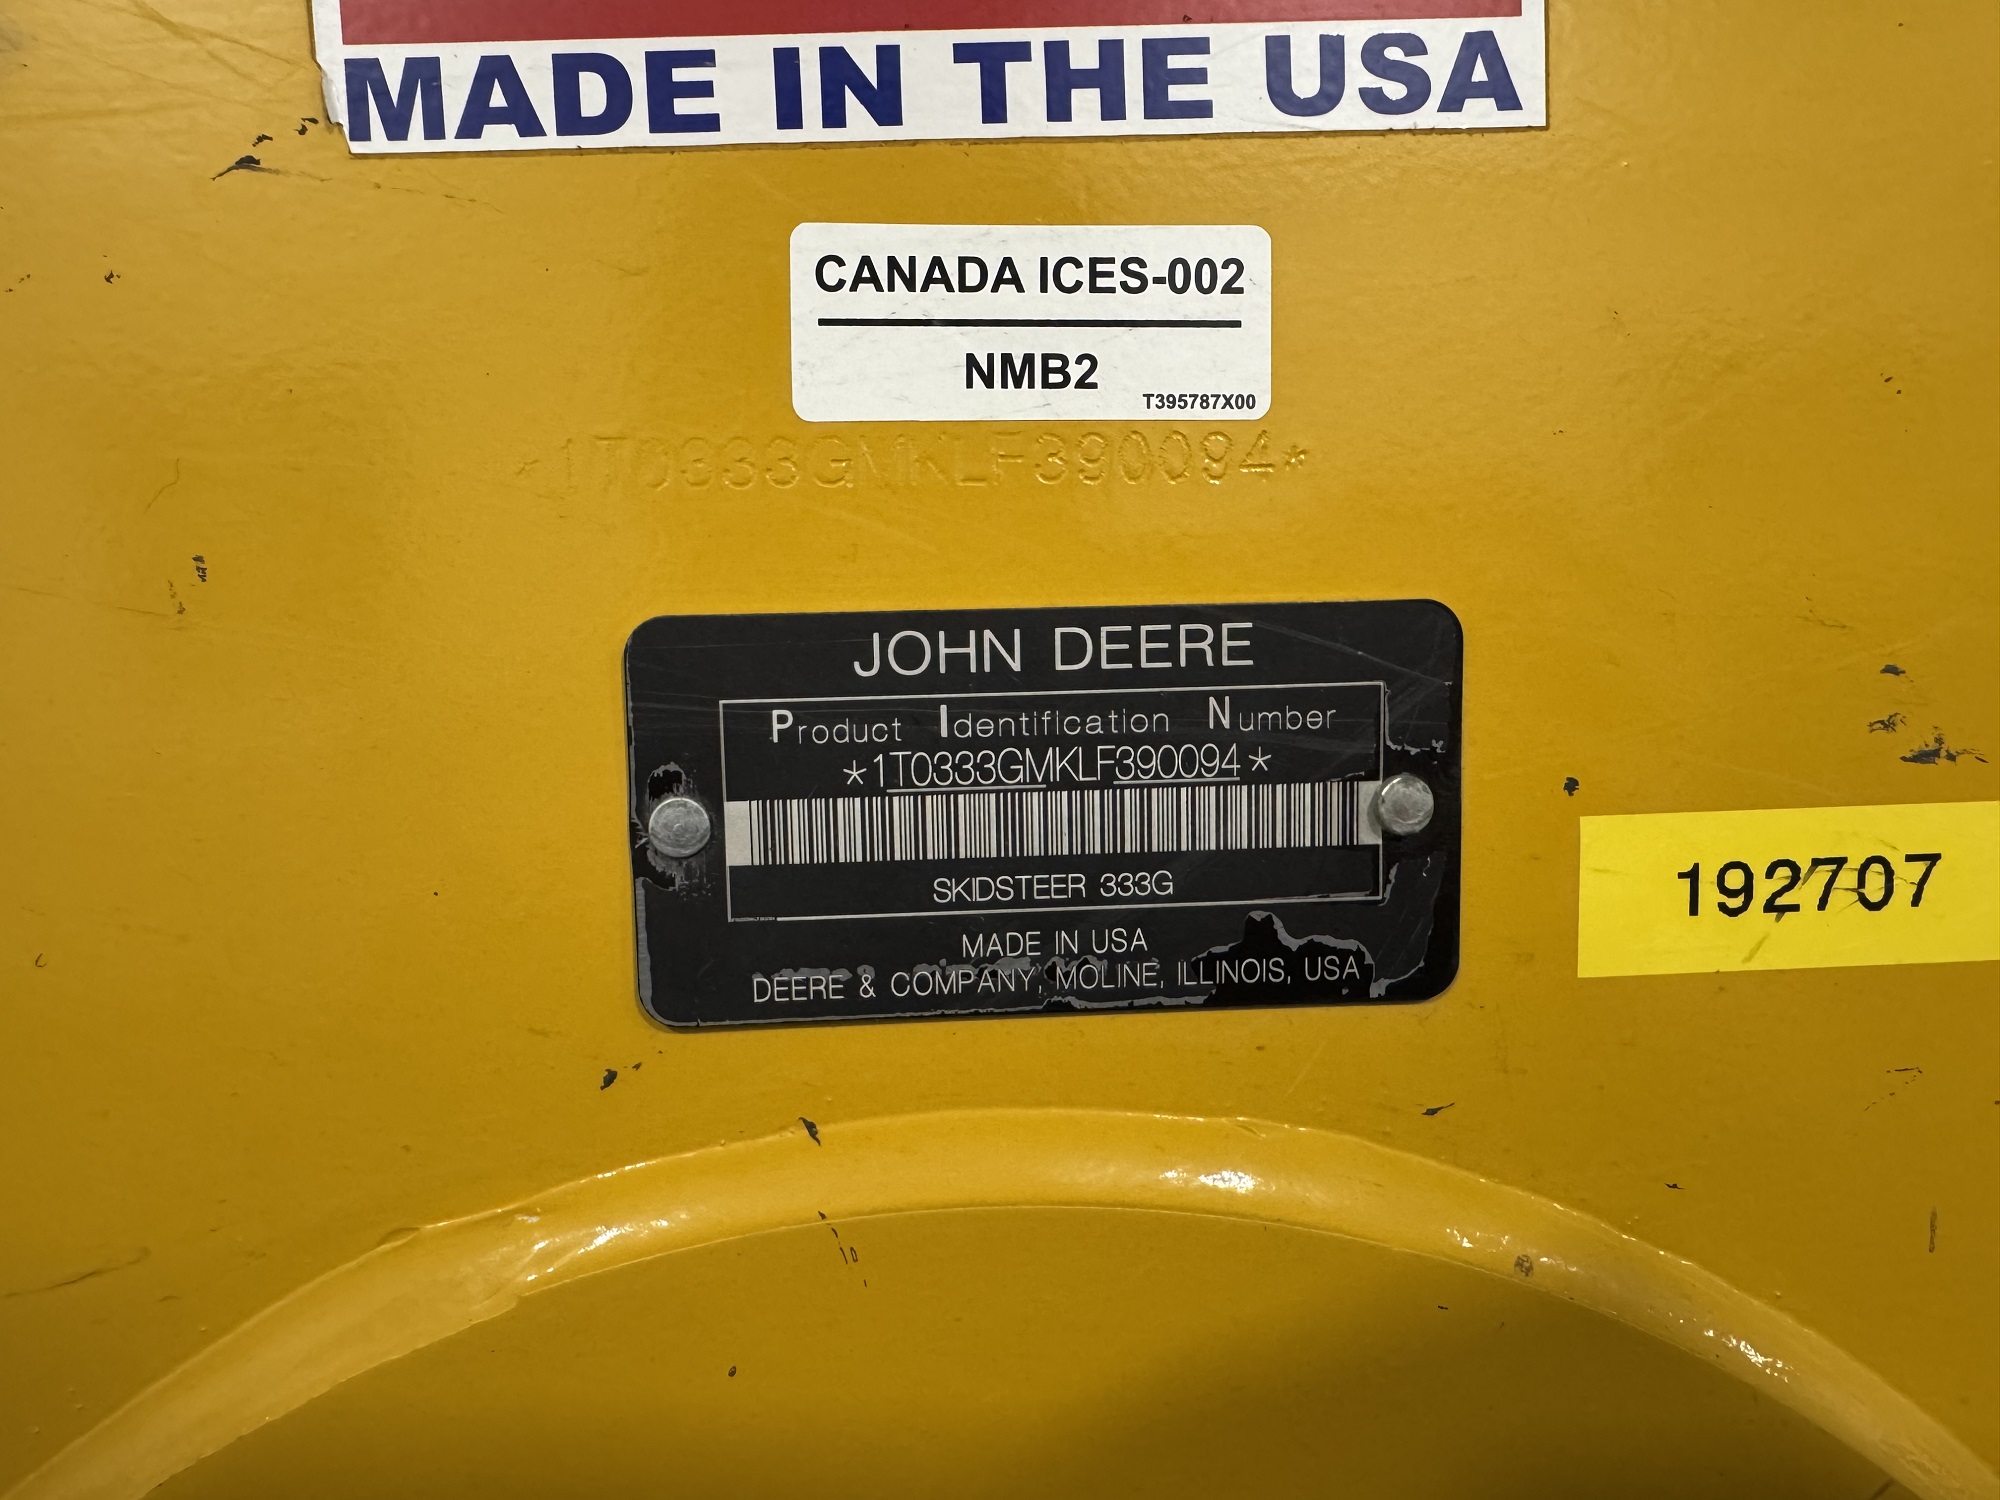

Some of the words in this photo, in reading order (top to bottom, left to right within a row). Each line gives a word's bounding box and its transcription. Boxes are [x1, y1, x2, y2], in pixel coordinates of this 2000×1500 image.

[344, 49, 721, 141] MADE
[773, 44, 903, 130] IN
[953, 36, 1214, 124] THE
[1265, 30, 1523, 117] USA
[814, 255, 1025, 294] CANADA
[1039, 256, 1246, 295] ICES-002
[965, 353, 1099, 391] NMB2
[1142, 393, 1257, 411] T395787X00
[853, 629, 1022, 677] JOHN
[1054, 622, 1254, 671] DEERE
[771, 709, 902, 744] Product
[939, 704, 1170, 739] Identification
[1208, 696, 1337, 732] Number
[932, 874, 1086, 903] SKIDSTEER
[1100, 870, 1174, 896] 333G
[1677, 852, 1942, 918] 192707
[962, 931, 1041, 958] MADE
[1055, 929, 1078, 955] IN
[1092, 927, 1148, 954] USA
[753, 973, 844, 1003] DEERE
[859, 973, 876, 999] &
[891, 967, 1042, 997] COMPANY,
[1056, 962, 1164, 991] MOLINE,
[1177, 956, 1292, 986] ILLINOIS,
[1304, 954, 1360, 982] USA
